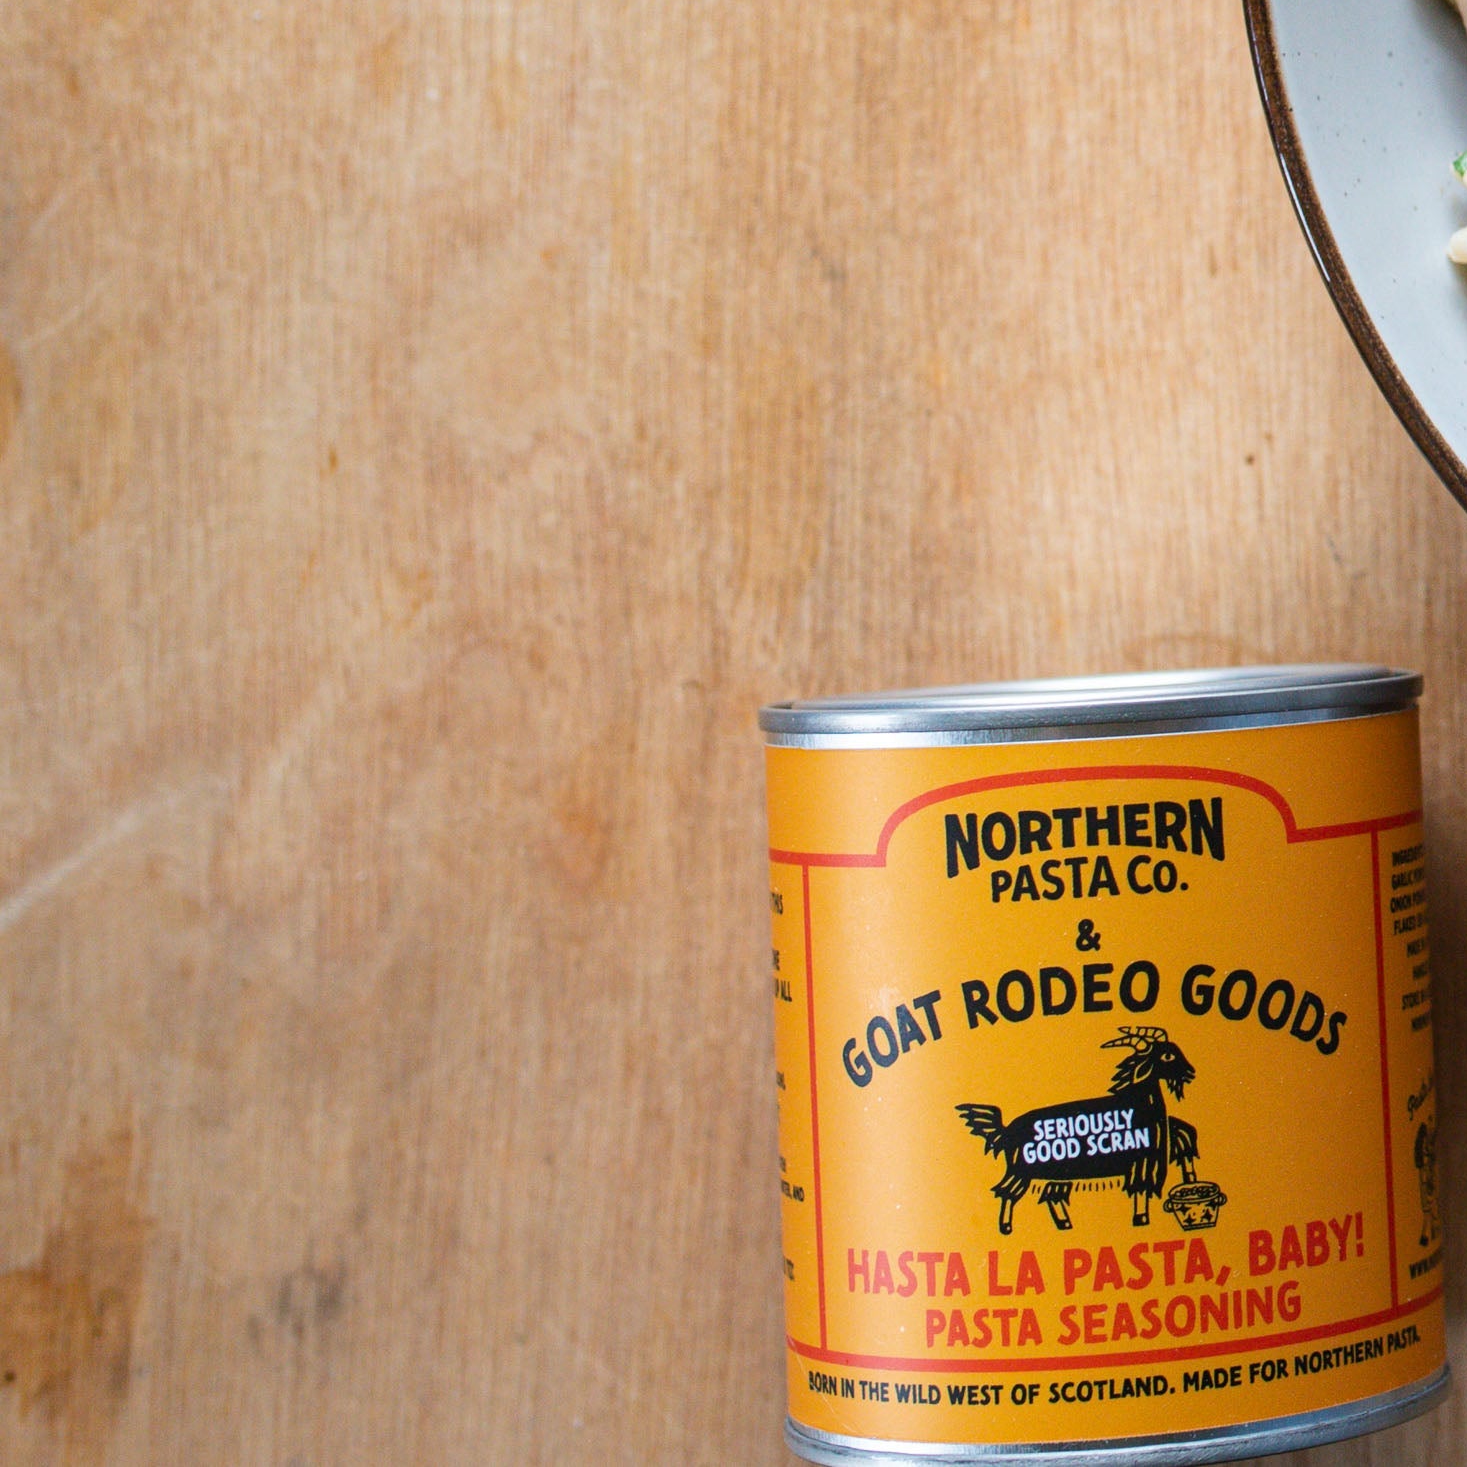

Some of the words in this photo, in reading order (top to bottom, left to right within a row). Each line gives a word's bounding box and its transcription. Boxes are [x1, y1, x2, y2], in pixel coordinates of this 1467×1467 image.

[945, 797, 1225, 878] NORTHERN
[991, 855, 1120, 903] PASTA
[1075, 918, 1101, 951] &
[842, 990, 942, 1088] GOAT
[961, 960, 1160, 1030] RODEO
[1180, 964, 1348, 1056] GOODS
[1022, 1137, 1081, 1165] GOOD
[1087, 1128, 1149, 1155] SCRAN
[1033, 1108, 1135, 1142] SERIOUSLY
[847, 1248, 972, 1298] HASTA
[988, 1249, 1046, 1297] LA
[1063, 1237, 1232, 1297] PASTA,
[1248, 1212, 1364, 1278] BABY!
[926, 1307, 1043, 1349] PASTA
[1057, 1280, 1301, 1344] SEASONING
[808, 1370, 837, 1396] BORN
[840, 1376, 855, 1399] IN
[859, 1380, 889, 1402] THE
[896, 1383, 941, 1405] WILD
[947, 1384, 1004, 1406] WEST
[1011, 1383, 1040, 1406] OF
[1048, 1375, 1176, 1403] SCOTLAND.
[1183, 1365, 1242, 1394] MADE
[1249, 1358, 1289, 1384] FOR
[1294, 1339, 1384, 1376] NORTHERN
